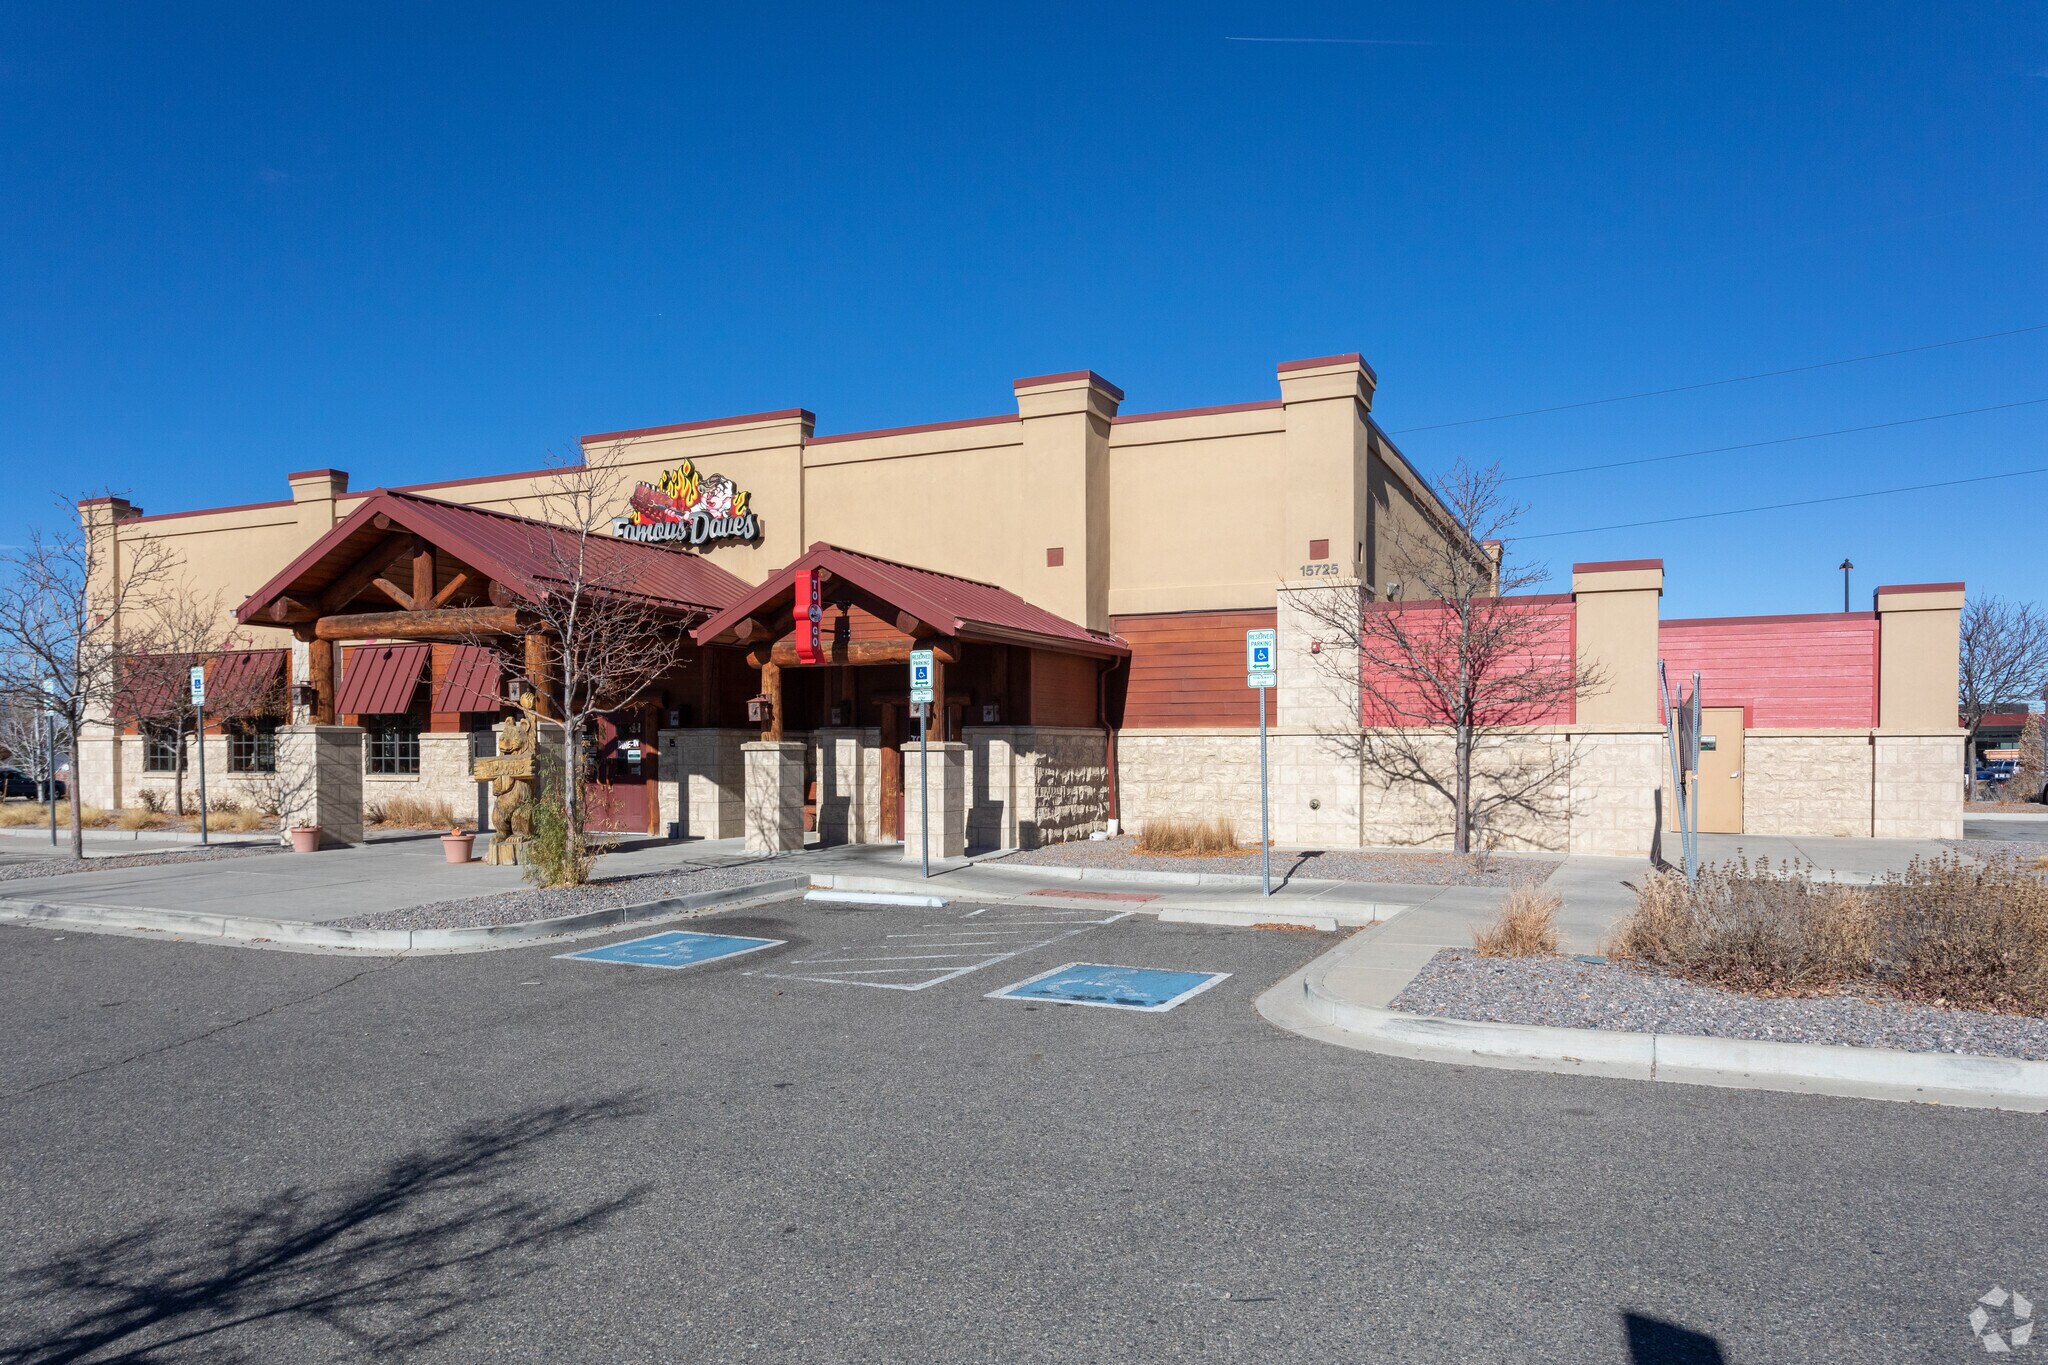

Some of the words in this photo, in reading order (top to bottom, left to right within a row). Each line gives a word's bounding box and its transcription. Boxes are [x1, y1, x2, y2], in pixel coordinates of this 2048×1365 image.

[612, 517, 686, 542] Famous
[1300, 563, 1339, 577] 15725
[812, 580, 818, 600] TO
[812, 626, 818, 647] GO
